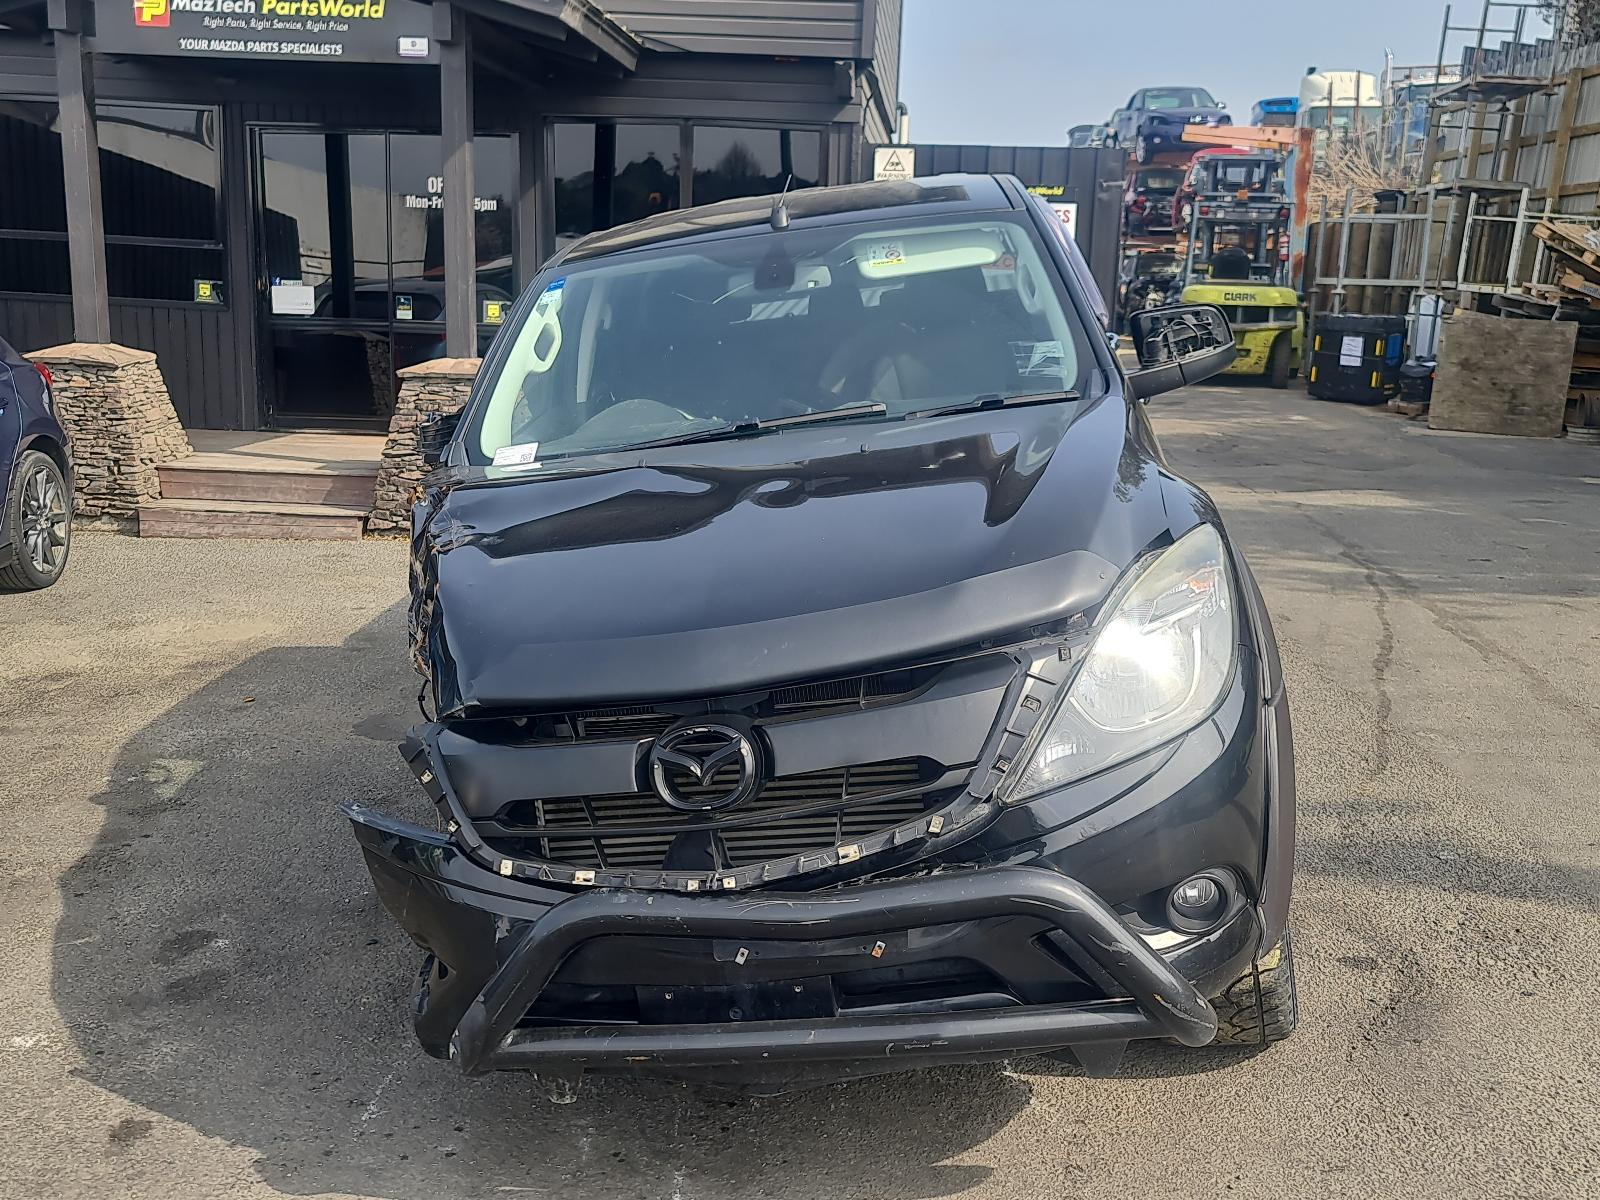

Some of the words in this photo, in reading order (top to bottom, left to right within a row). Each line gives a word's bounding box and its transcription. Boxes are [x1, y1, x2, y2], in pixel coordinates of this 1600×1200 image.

[261, 0, 385, 18] PartsWorld
[203, 16, 225, 28] Right
[250, 18, 271, 30] Right
[273, 19, 304, 30] Service,
[306, 20, 327, 32] Right
[328, 22, 349, 31] Price
[179, 38, 209, 49] YOUR
[209, 40, 246, 51] MAZDA
[246, 41, 279, 53] PARTS
[280, 42, 343, 55] SPECIALISTS
[1224, 292, 1257, 301] CLARK
